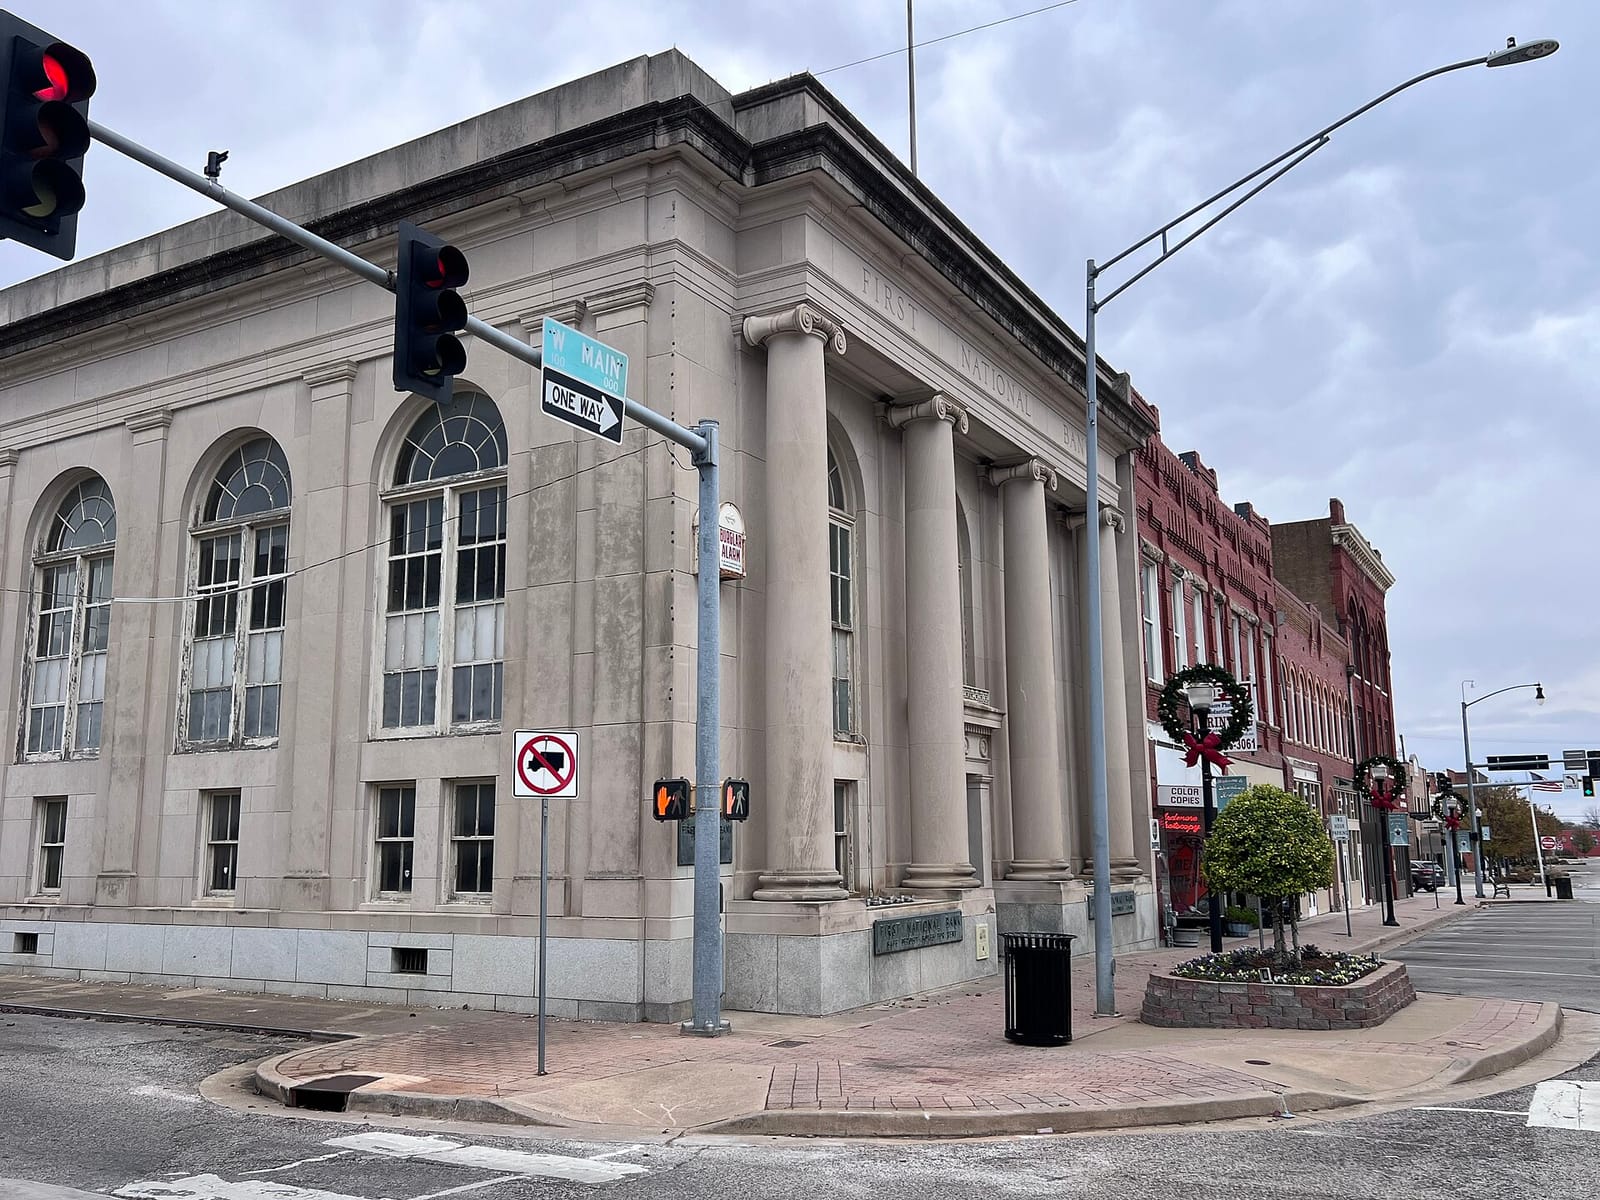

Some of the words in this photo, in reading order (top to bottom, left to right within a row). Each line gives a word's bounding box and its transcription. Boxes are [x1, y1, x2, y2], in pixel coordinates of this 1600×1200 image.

[552, 328, 565, 352] W
[581, 342, 620, 379] MAIN
[862, 266, 918, 332] FIRST
[961, 344, 1032, 417] NATIONAL
[1063, 422, 1086, 457] BAN
[552, 385, 576, 411] ONE
[580, 397, 604, 422] WAY
[720, 528, 742, 549] BURGLAR
[721, 543, 741, 563] ALARM
[1170, 796, 1200, 804] COPIES
[1171, 787, 1199, 796] COLOR
[880, 922, 901, 938] FIRST
